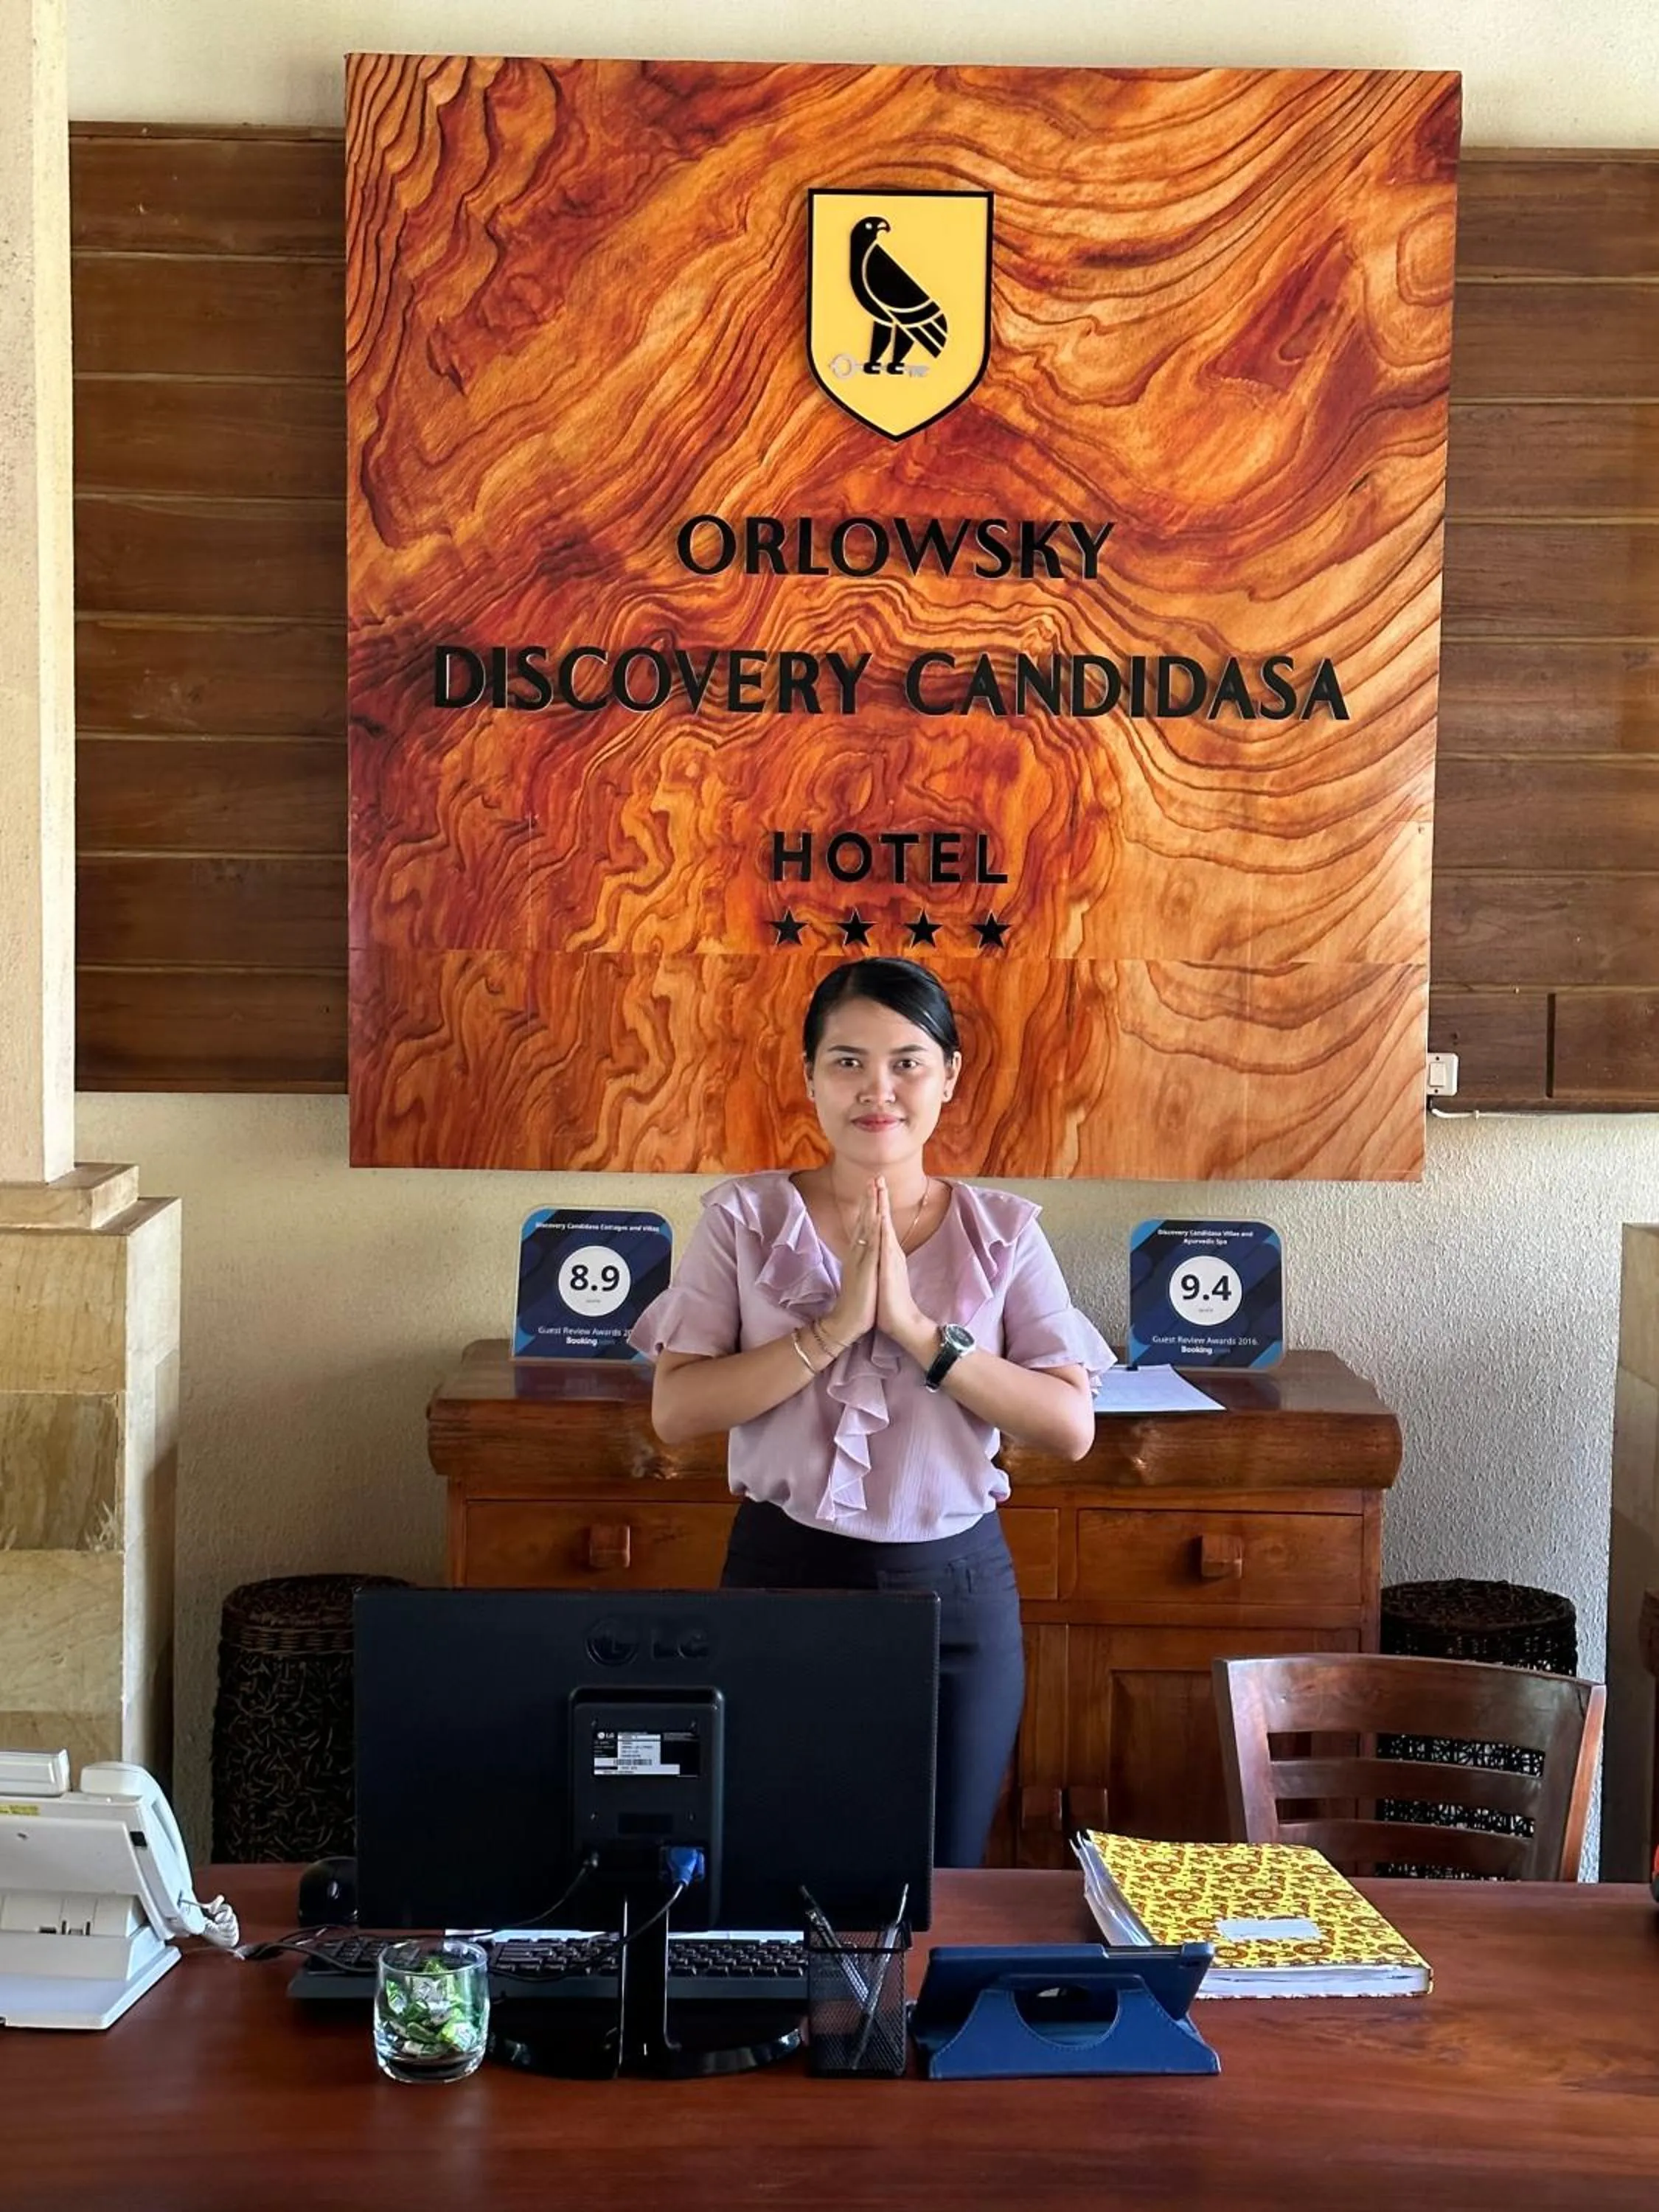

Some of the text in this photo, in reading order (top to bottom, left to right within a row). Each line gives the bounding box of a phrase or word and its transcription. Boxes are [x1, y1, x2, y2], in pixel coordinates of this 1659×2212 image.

[677, 514, 1116, 580] ORLOWSKY
[434, 645, 1351, 721] DISCOVERY CANDIDASA
[772, 830, 1009, 884] HOTEL
[570, 1265, 620, 1292] 8.9
[1180, 1274, 1232, 1301] 9.4
[538, 1326, 561, 1334] Guest
[563, 1326, 591, 1335] Review
[592, 1327, 622, 1336] Awards
[1152, 1335, 1175, 1343] Guest
[1178, 1336, 1206, 1344] Review
[1206, 1337, 1237, 1346] Awards
